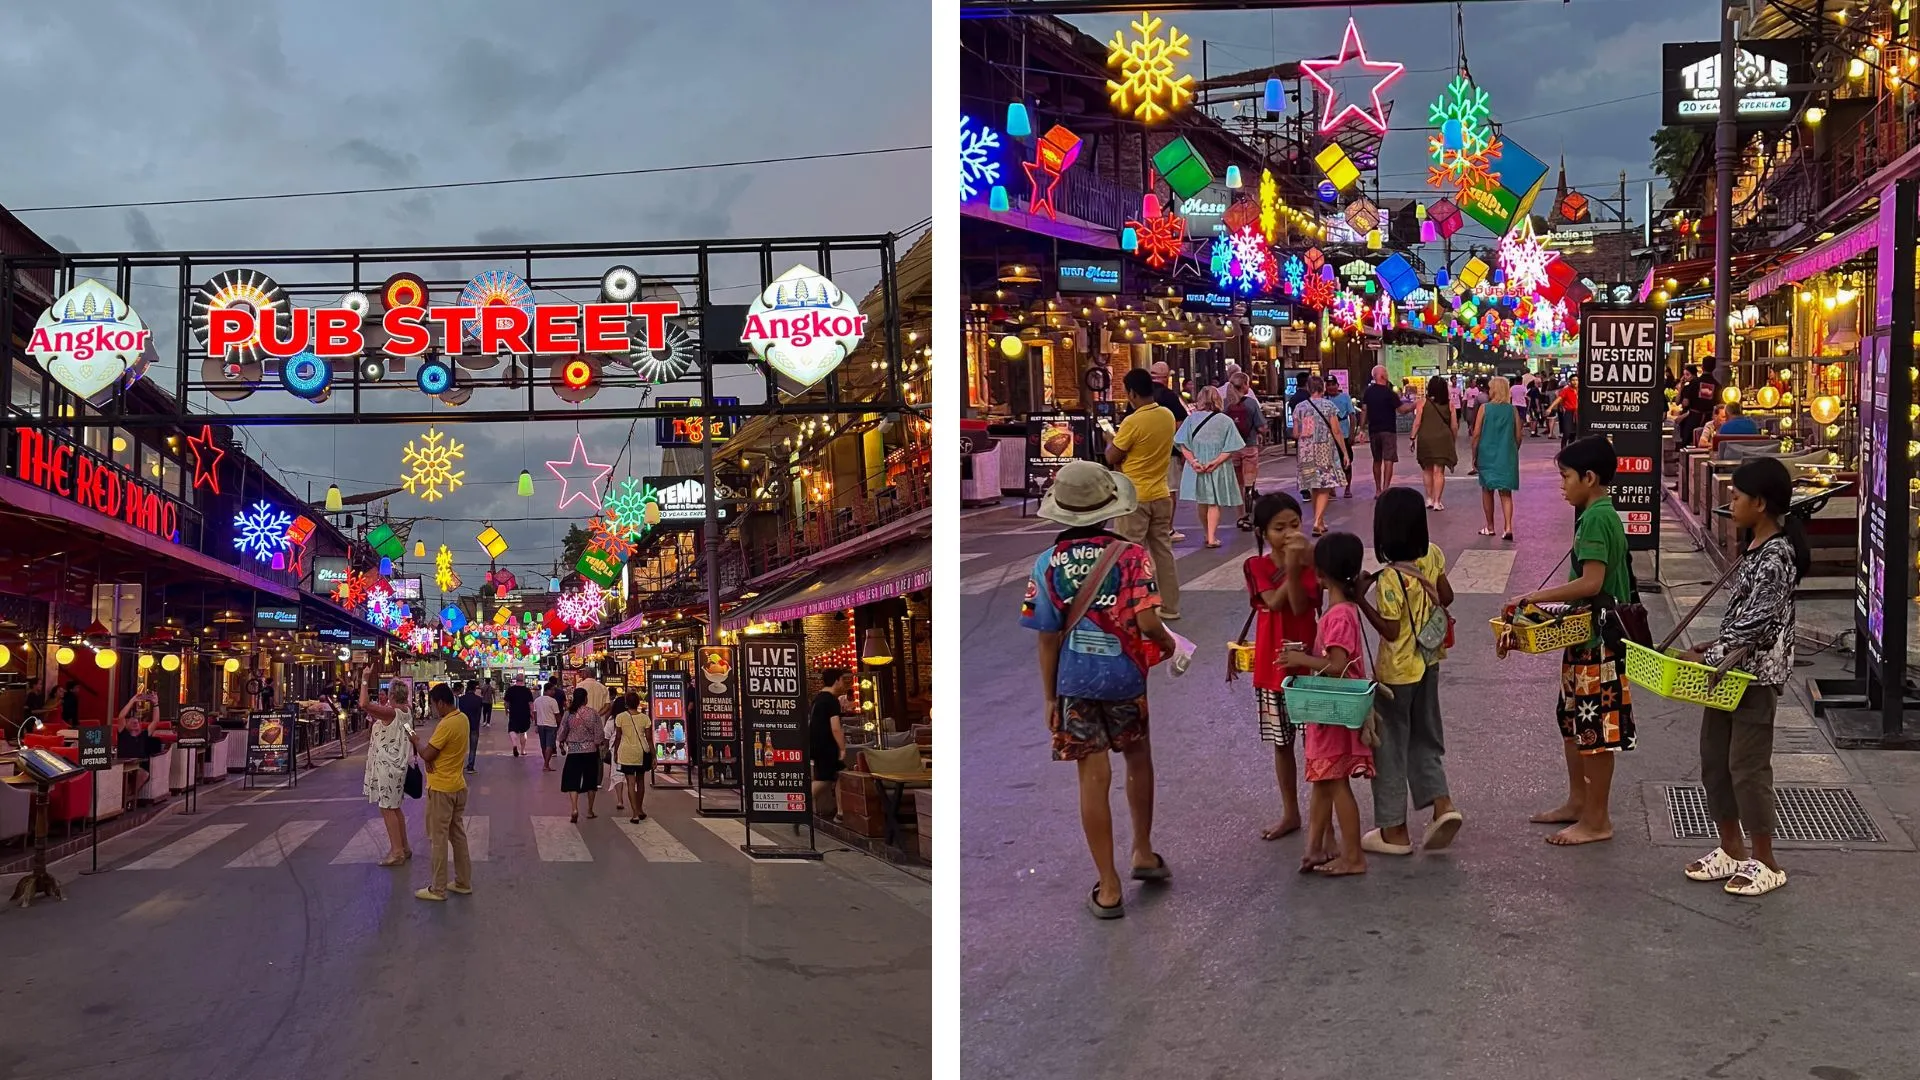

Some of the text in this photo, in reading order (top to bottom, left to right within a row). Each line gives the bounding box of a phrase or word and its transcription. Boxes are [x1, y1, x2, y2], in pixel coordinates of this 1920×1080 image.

[1683, 103, 1697, 112] 20
[1699, 103, 1721, 111] YEA
[1470, 187, 1509, 219] TEMPLE
[208, 300, 680, 358] PUB STREET
[740, 311, 868, 346] Angkor
[1591, 322, 1654, 347] LIVE
[25, 325, 150, 361] Angkor
[1591, 348, 1653, 362] WESTERN
[1590, 364, 1653, 382] BAND
[1592, 392, 1650, 404] UPSTAIRS
[1619, 458, 1650, 471] $1.00
[16, 427, 177, 541] THE RED PIANO
[1622, 486, 1653, 495] SPIRIT
[1618, 496, 1651, 504] MIXER
[1050, 546, 1105, 568] We Wan
[748, 648, 796, 666] LIVE
[750, 666, 797, 677] WESTERN
[750, 678, 797, 693] BAND
[658, 701, 679, 716] 1+1
[702, 704, 733, 712] ICE-CREAM
[752, 698, 797, 709] UPSTAIRS
[82, 758, 108, 766] UPSTAIRS
[777, 750, 801, 761] $1.00
[753, 772, 805, 780] HOUSE SPIRIT
